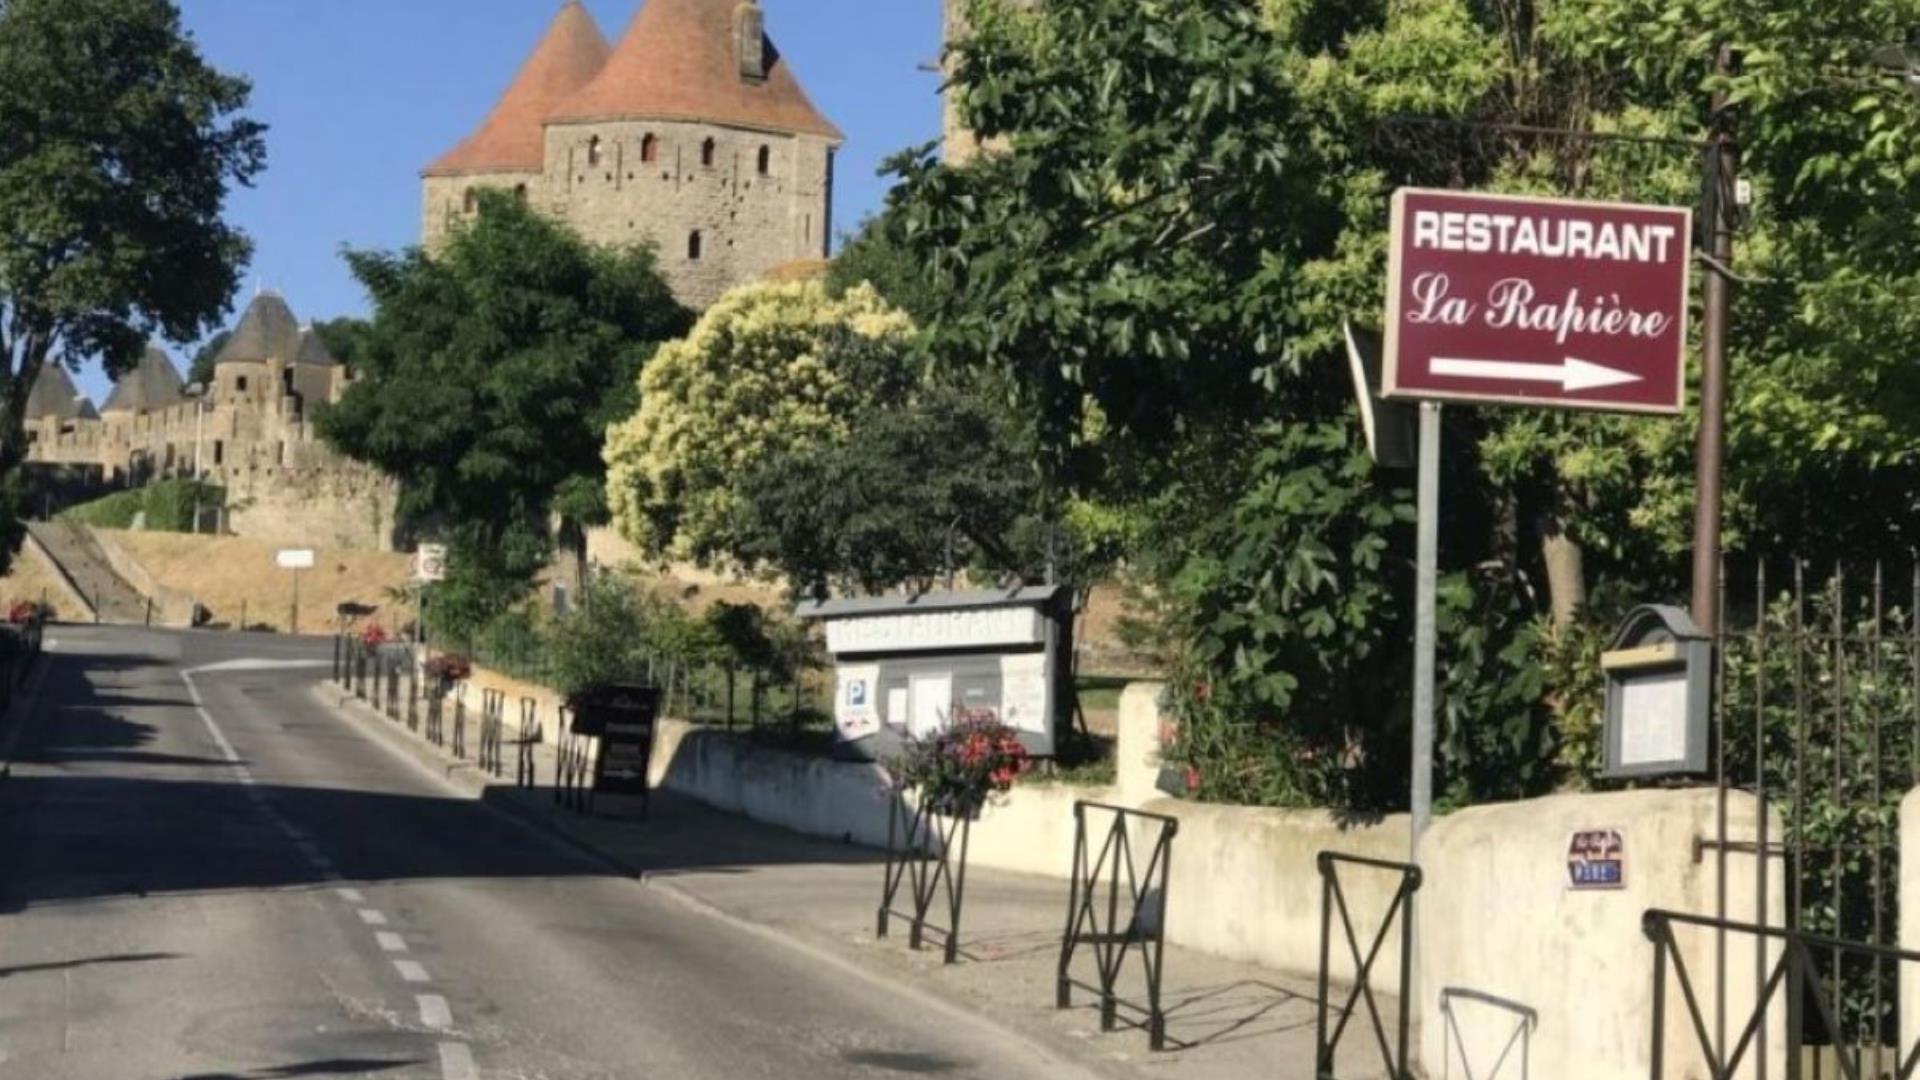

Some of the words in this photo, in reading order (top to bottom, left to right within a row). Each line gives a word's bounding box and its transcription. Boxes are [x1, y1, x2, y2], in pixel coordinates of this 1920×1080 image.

[1413, 210, 1675, 263] RESTAURANT
[1406, 271, 1477, 326] La
[1484, 277, 1673, 344] Rapière
